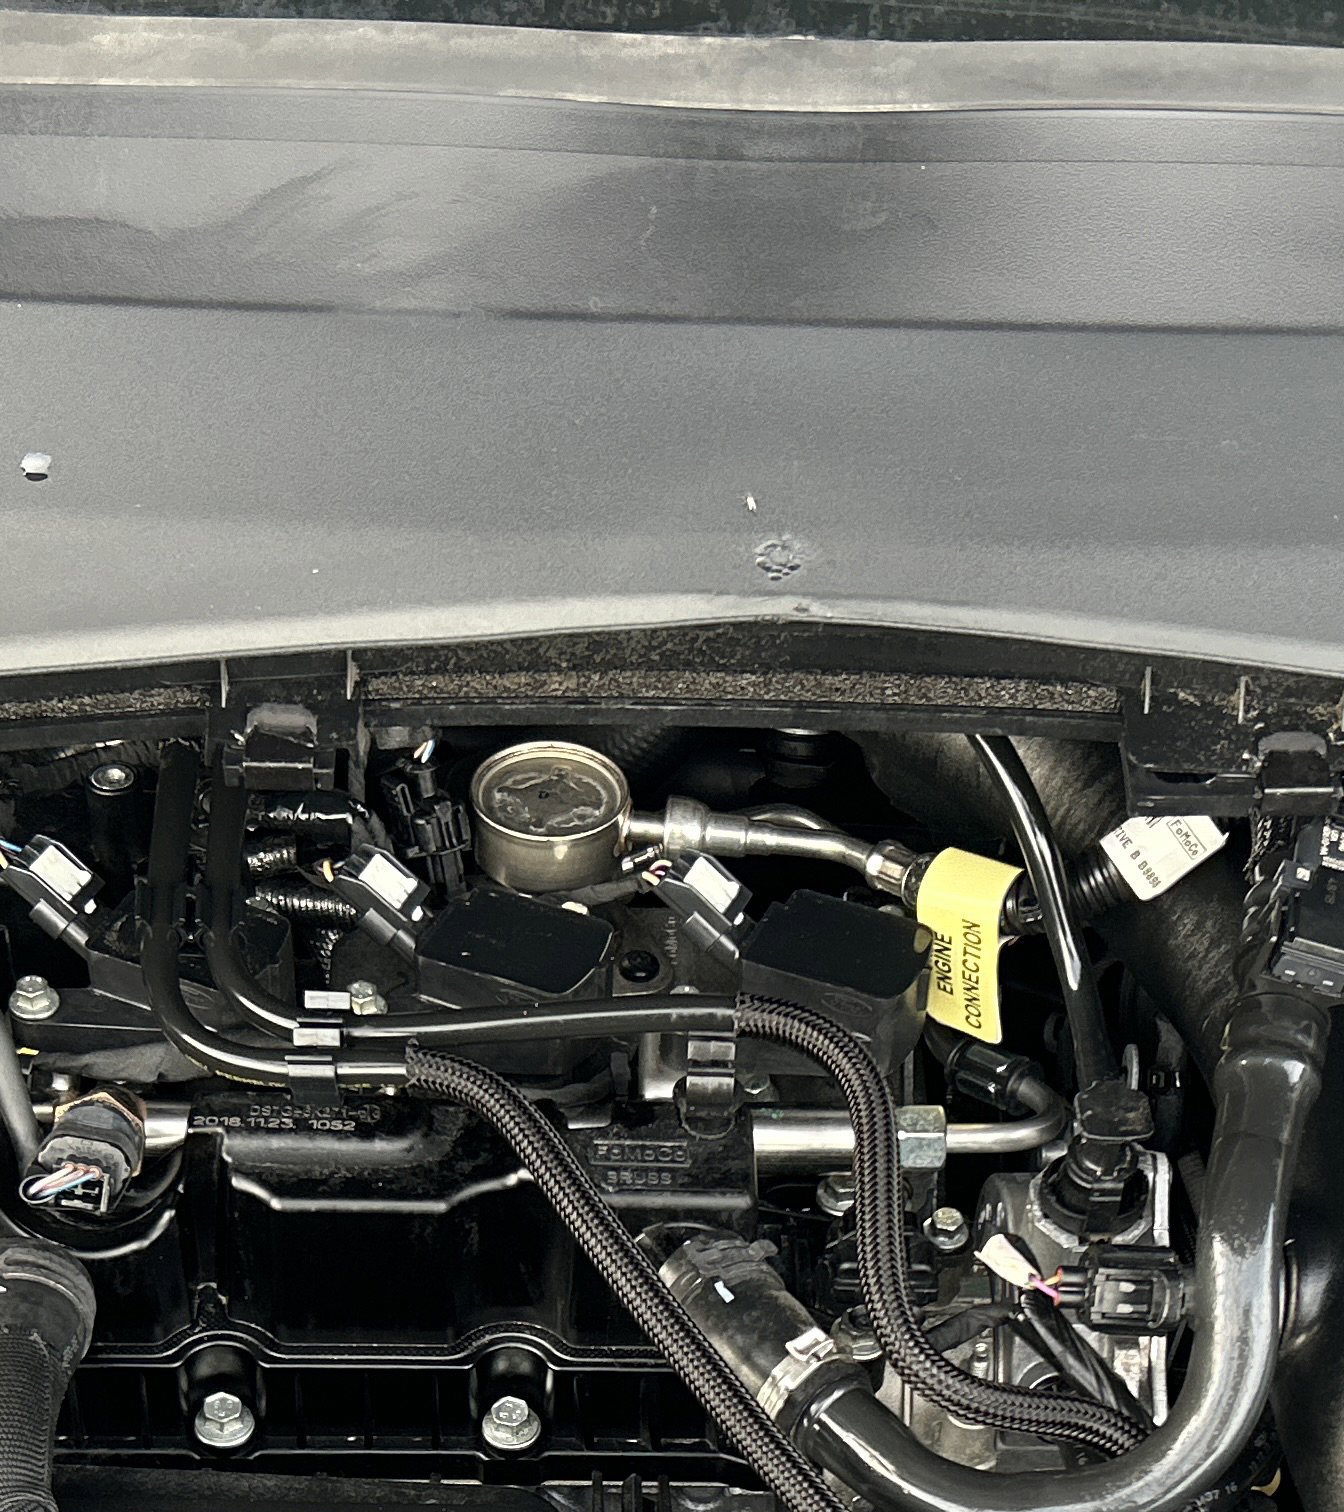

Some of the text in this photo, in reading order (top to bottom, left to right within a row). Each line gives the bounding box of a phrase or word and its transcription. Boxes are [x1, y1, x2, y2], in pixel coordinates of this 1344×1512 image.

[1171, 819, 1199, 856] FoMoCo
[934, 932, 954, 995] ENGINE
[962, 919, 982, 1029] CONNECTION
[193, 1116, 297, 1130] 2018.11.23.
[596, 1145, 685, 1161] FoMoCo
